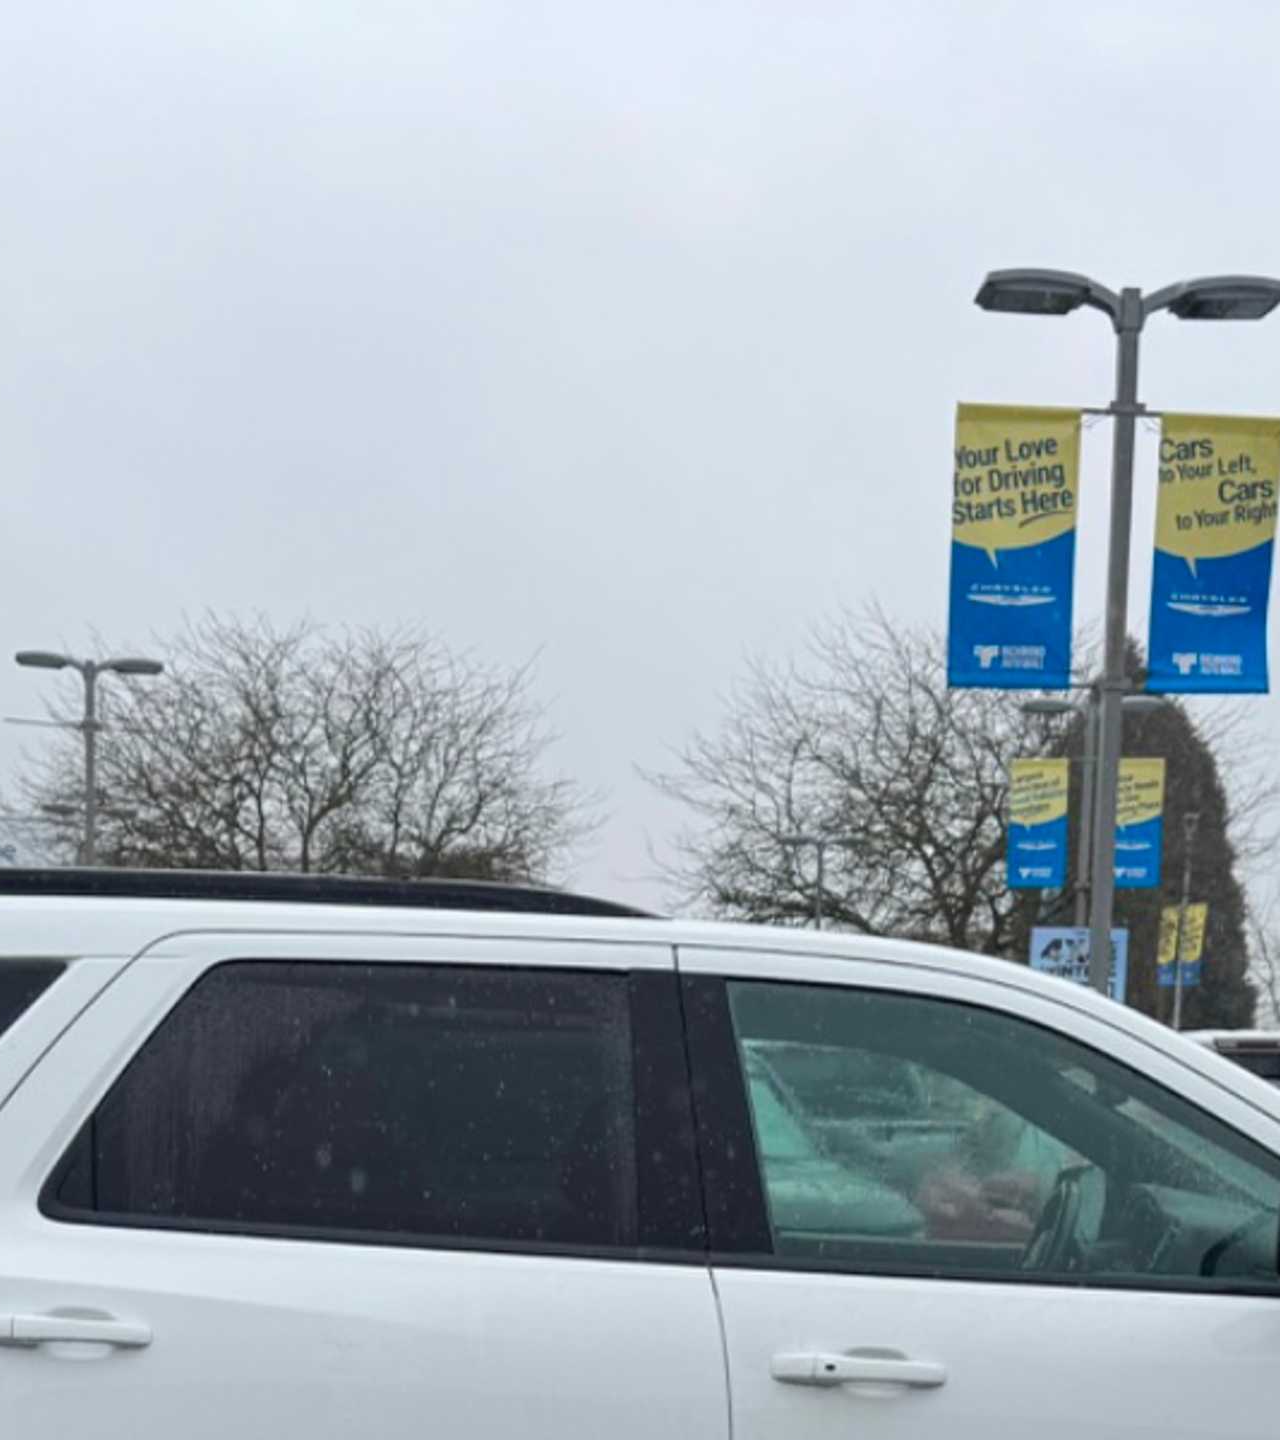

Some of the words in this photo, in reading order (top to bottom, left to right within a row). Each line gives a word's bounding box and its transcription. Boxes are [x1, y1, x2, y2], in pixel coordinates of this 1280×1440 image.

[1004, 438, 1058, 462] Love
[1159, 437, 1214, 464] Cars
[987, 461, 1066, 489] Driving
[1176, 463, 1213, 480] Your
[1218, 478, 1274, 504] Cars
[951, 496, 1017, 525] Starts
[1020, 489, 1073, 514] Here
[1175, 513, 1193, 531] to
[1193, 508, 1231, 527] Your
